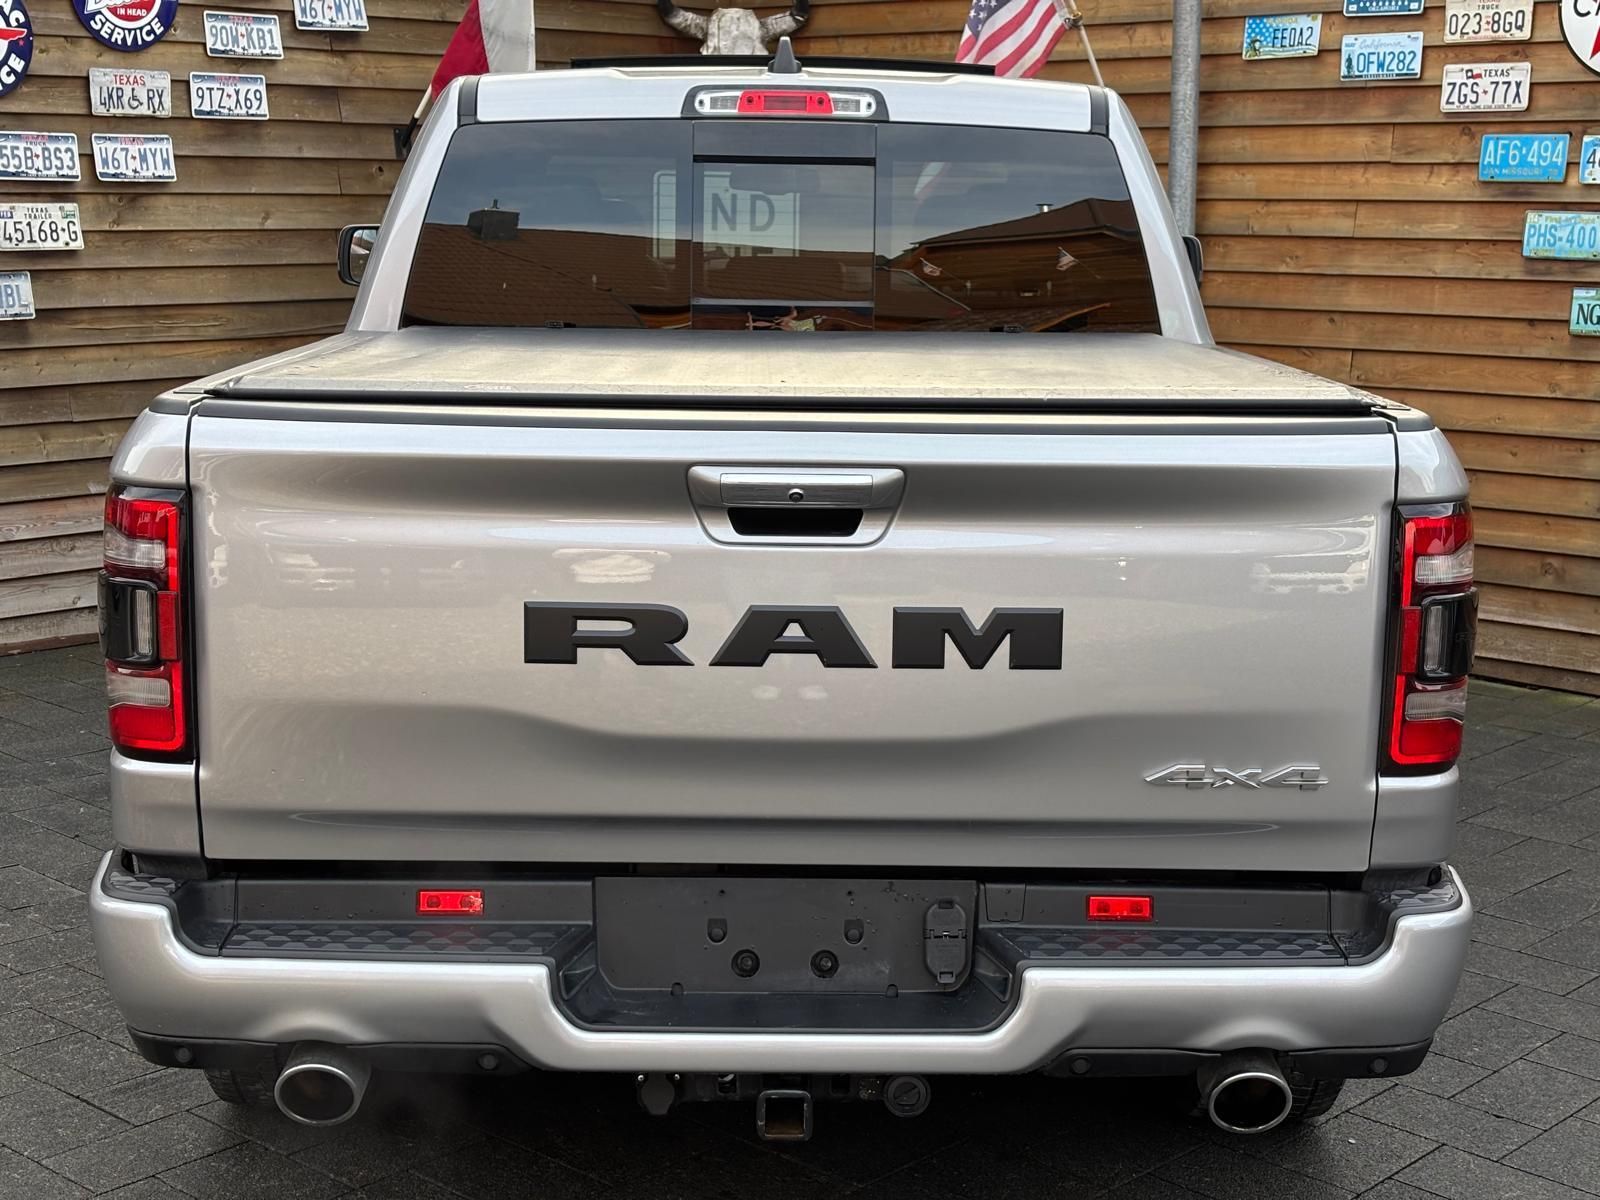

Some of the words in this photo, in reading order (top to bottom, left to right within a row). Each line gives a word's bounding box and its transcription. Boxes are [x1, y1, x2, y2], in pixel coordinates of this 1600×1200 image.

[127, 8, 147, 16] HEAD
[89, 14, 164, 46] SERVICE
[113, 74, 146, 86] TEXAS
[1483, 68, 1511, 78] TEXAS
[99, 86, 125, 110] 4KR
[147, 88, 165, 111] RX
[523, 601, 1064, 671] RAM
